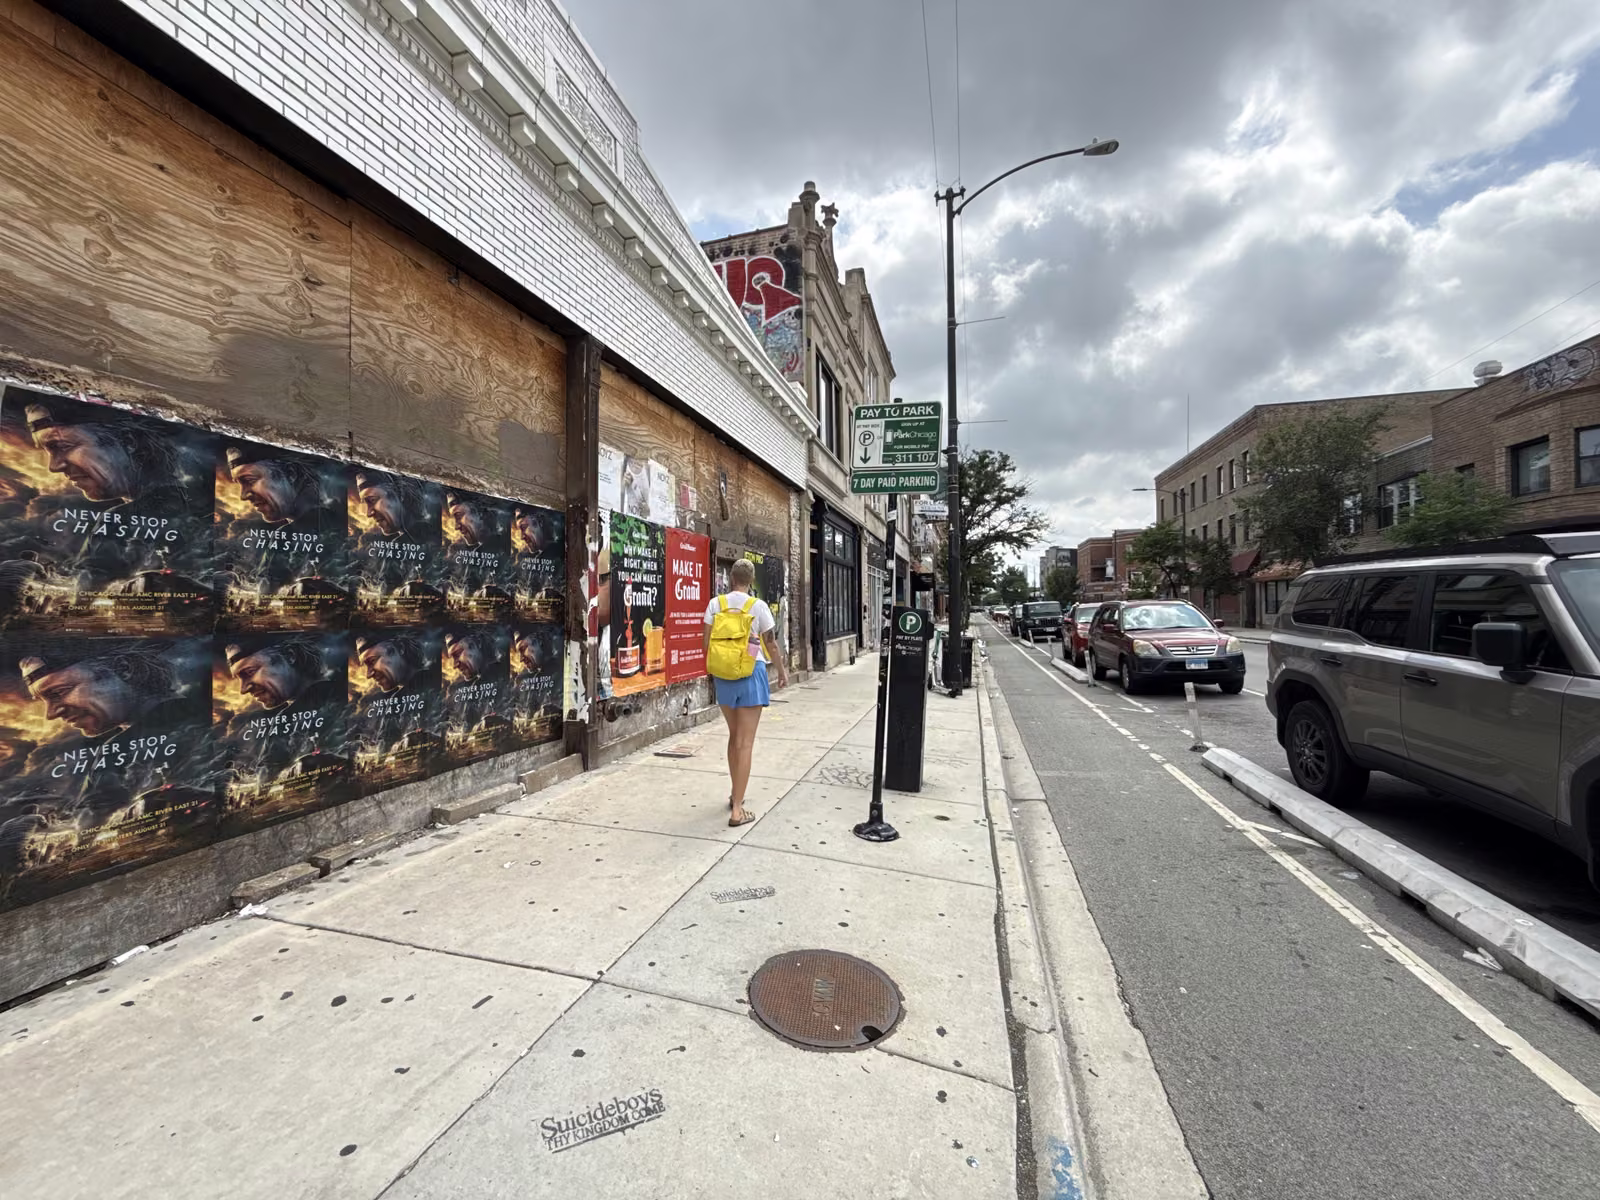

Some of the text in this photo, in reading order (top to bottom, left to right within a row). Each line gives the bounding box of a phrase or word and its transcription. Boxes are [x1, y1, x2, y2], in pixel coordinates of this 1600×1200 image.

[860, 405, 934, 418] PAY TO PARK
[895, 454, 912, 462] 311
[917, 453, 935, 461] 107
[853, 475, 936, 488] 7 DAY PAID PARKING
[65, 508, 169, 528] NEVER STOP
[53, 519, 178, 541] CHASING
[250, 529, 318, 542] NEVER STOP
[243, 538, 324, 553] CHASING
[373, 541, 421, 551] NEVER STOP
[623, 543, 658, 558] WHY MAKE IT
[368, 548, 425, 560] CHASING
[459, 550, 479, 558] NEVER
[456, 556, 499, 568] CHASING
[521, 563, 555, 572] CHASING
[642, 561, 658, 571] WHEN
[672, 558, 703, 578] MAKE IT
[617, 570, 662, 584] YOU CAN MAKE IT
[624, 583, 658, 606] Grand?
[675, 578, 701, 600] Grand
[906, 615, 917, 630] P
[458, 685, 477, 694] NEVER
[520, 680, 554, 692] CHASING
[373, 694, 420, 707] NEVER STOP
[454, 688, 498, 702] CHASING
[367, 701, 425, 718] CHASING
[250, 710, 317, 728] NEVER STOP
[243, 717, 324, 741] CHASING
[64, 735, 167, 762] NEVER STOP
[52, 743, 177, 778] CHASING
[137, 811, 154, 822] AMC
[155, 807, 173, 816] RIVER
[174, 802, 190, 811] EAST
[71, 843, 90, 853] ONLY
[134, 824, 158, 836] AUGUST
[545, 1101, 666, 1151] THY KINGDOM COME
